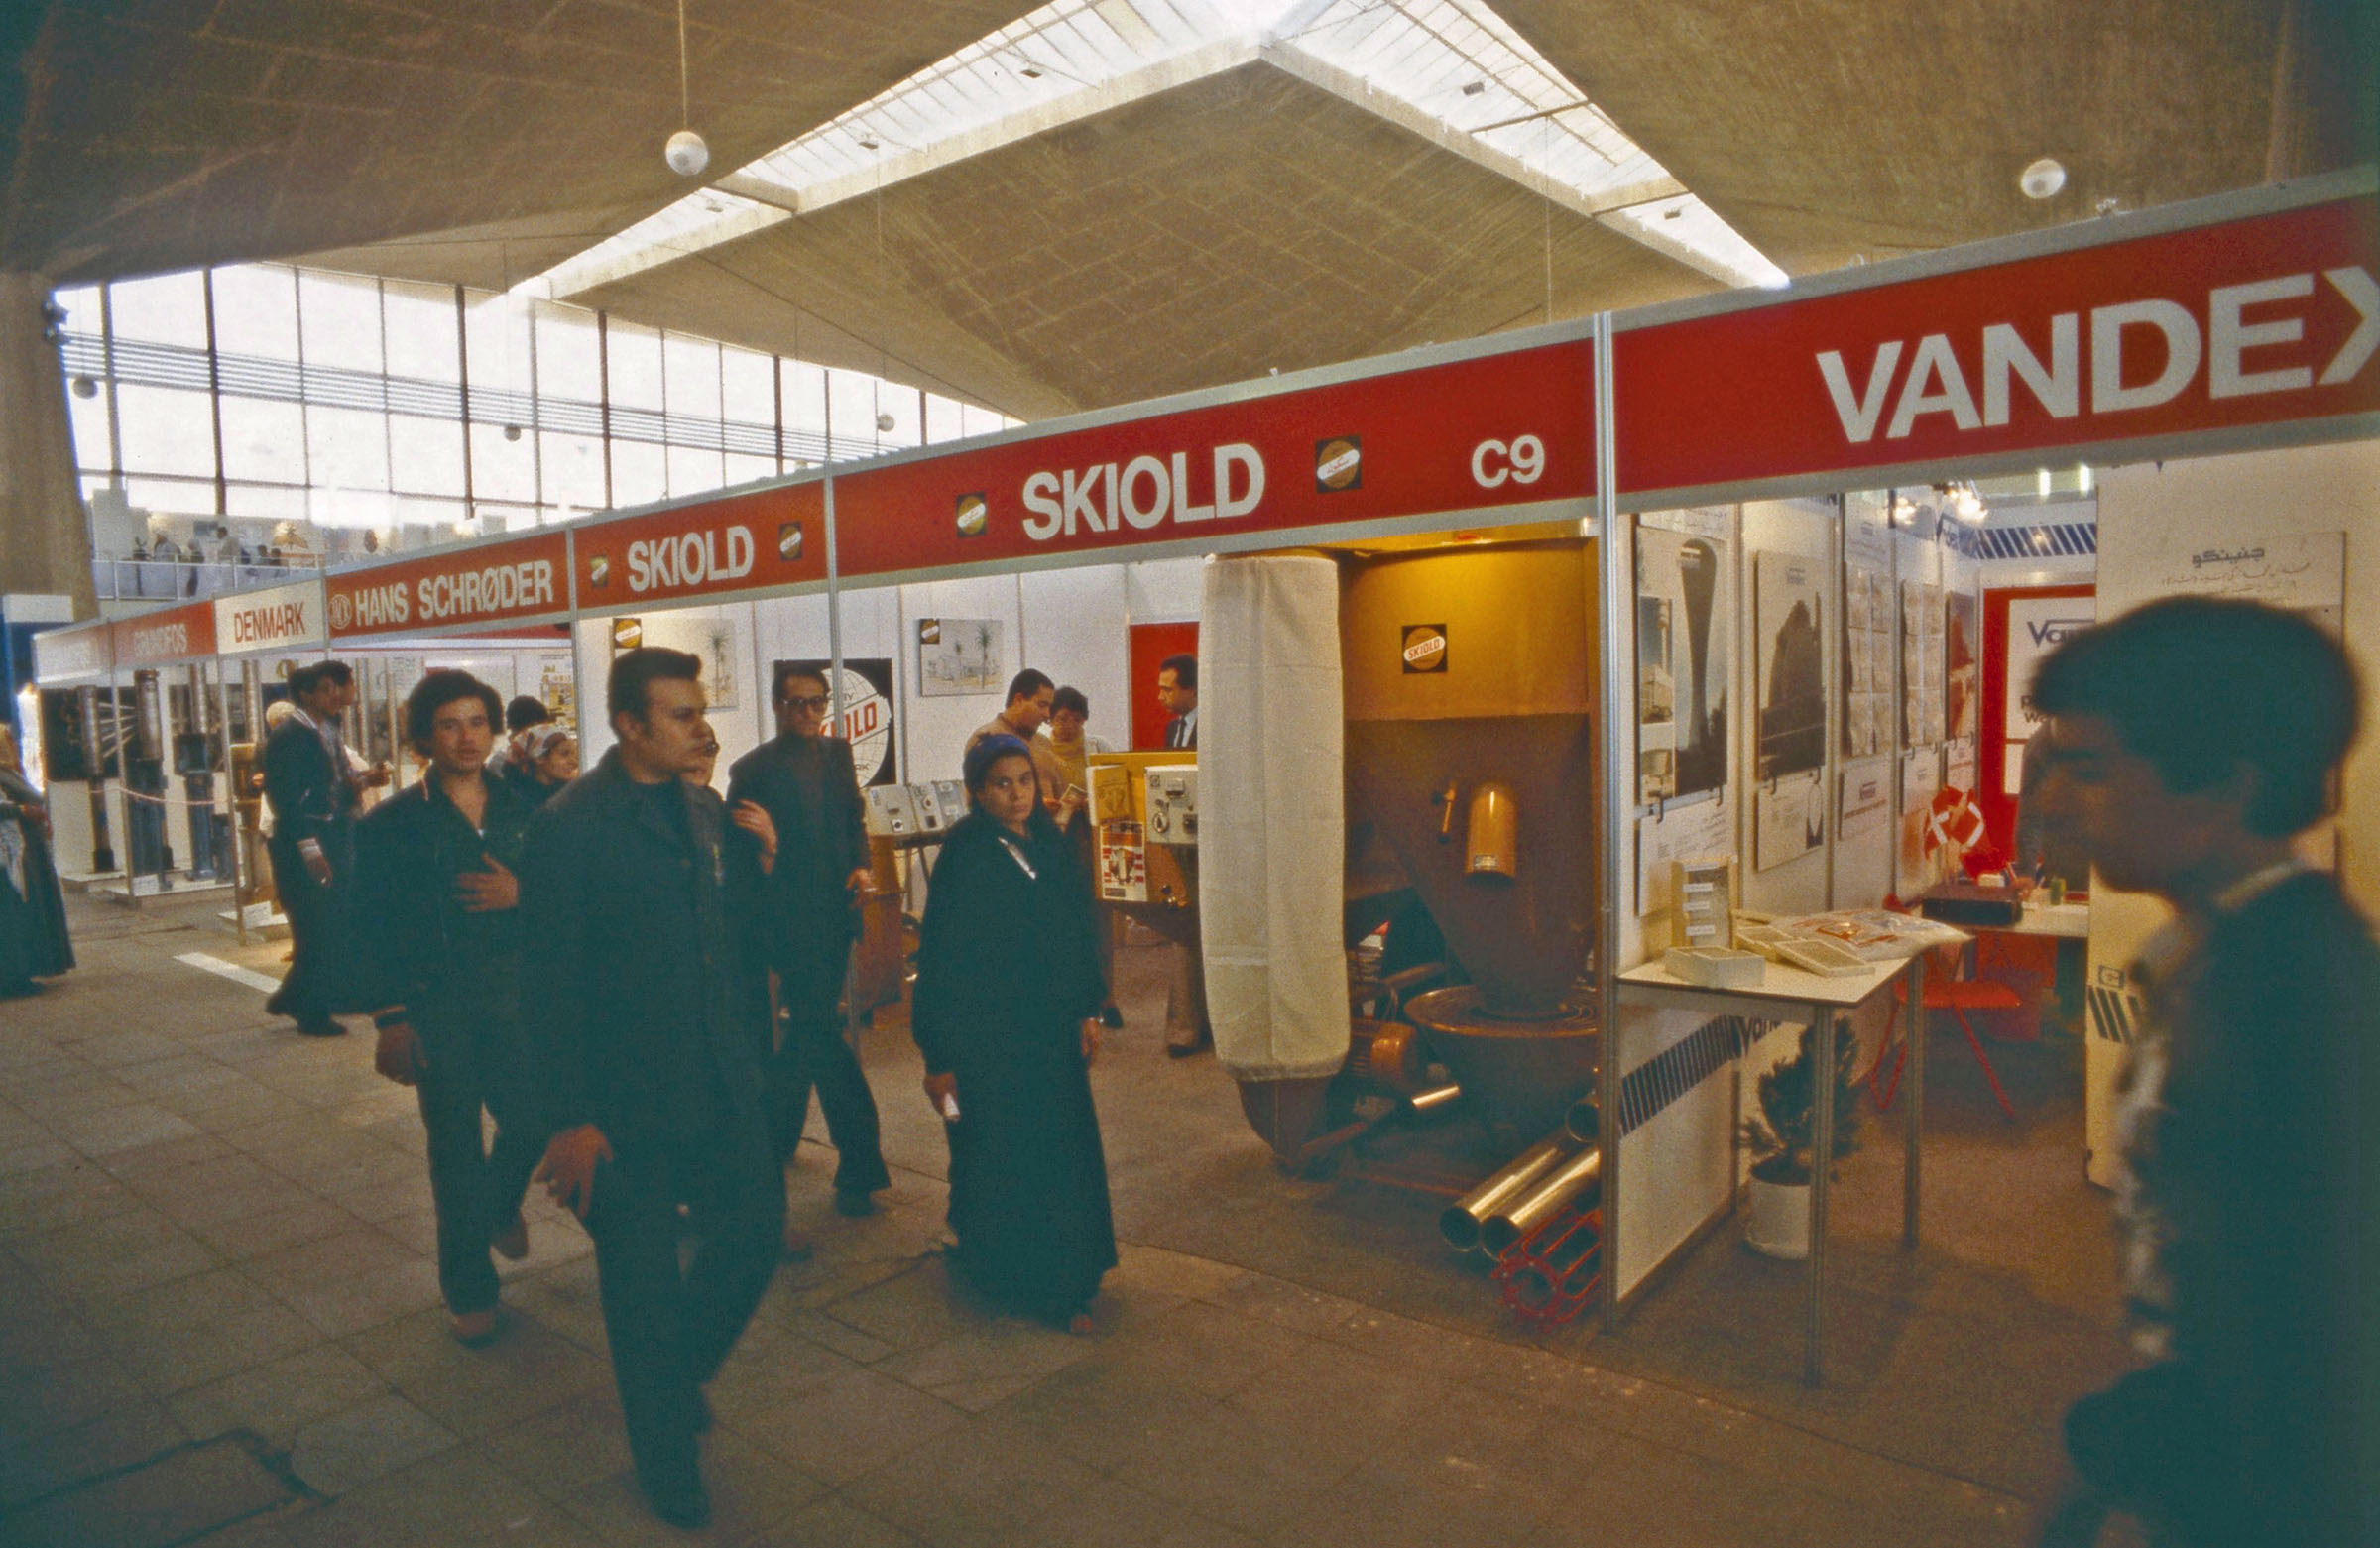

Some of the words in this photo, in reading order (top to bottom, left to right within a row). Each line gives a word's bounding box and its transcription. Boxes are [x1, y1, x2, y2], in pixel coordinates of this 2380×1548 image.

[1022, 442, 1266, 540] SKIOLD
[1472, 434, 1545, 488] C9
[628, 525, 755, 592] SKIOLD
[234, 601, 306, 643] DENMARK
[354, 583, 411, 627] HANS
[418, 559, 554, 621] SCHRØDER
[1408, 638, 1441, 660] SKIOLD
